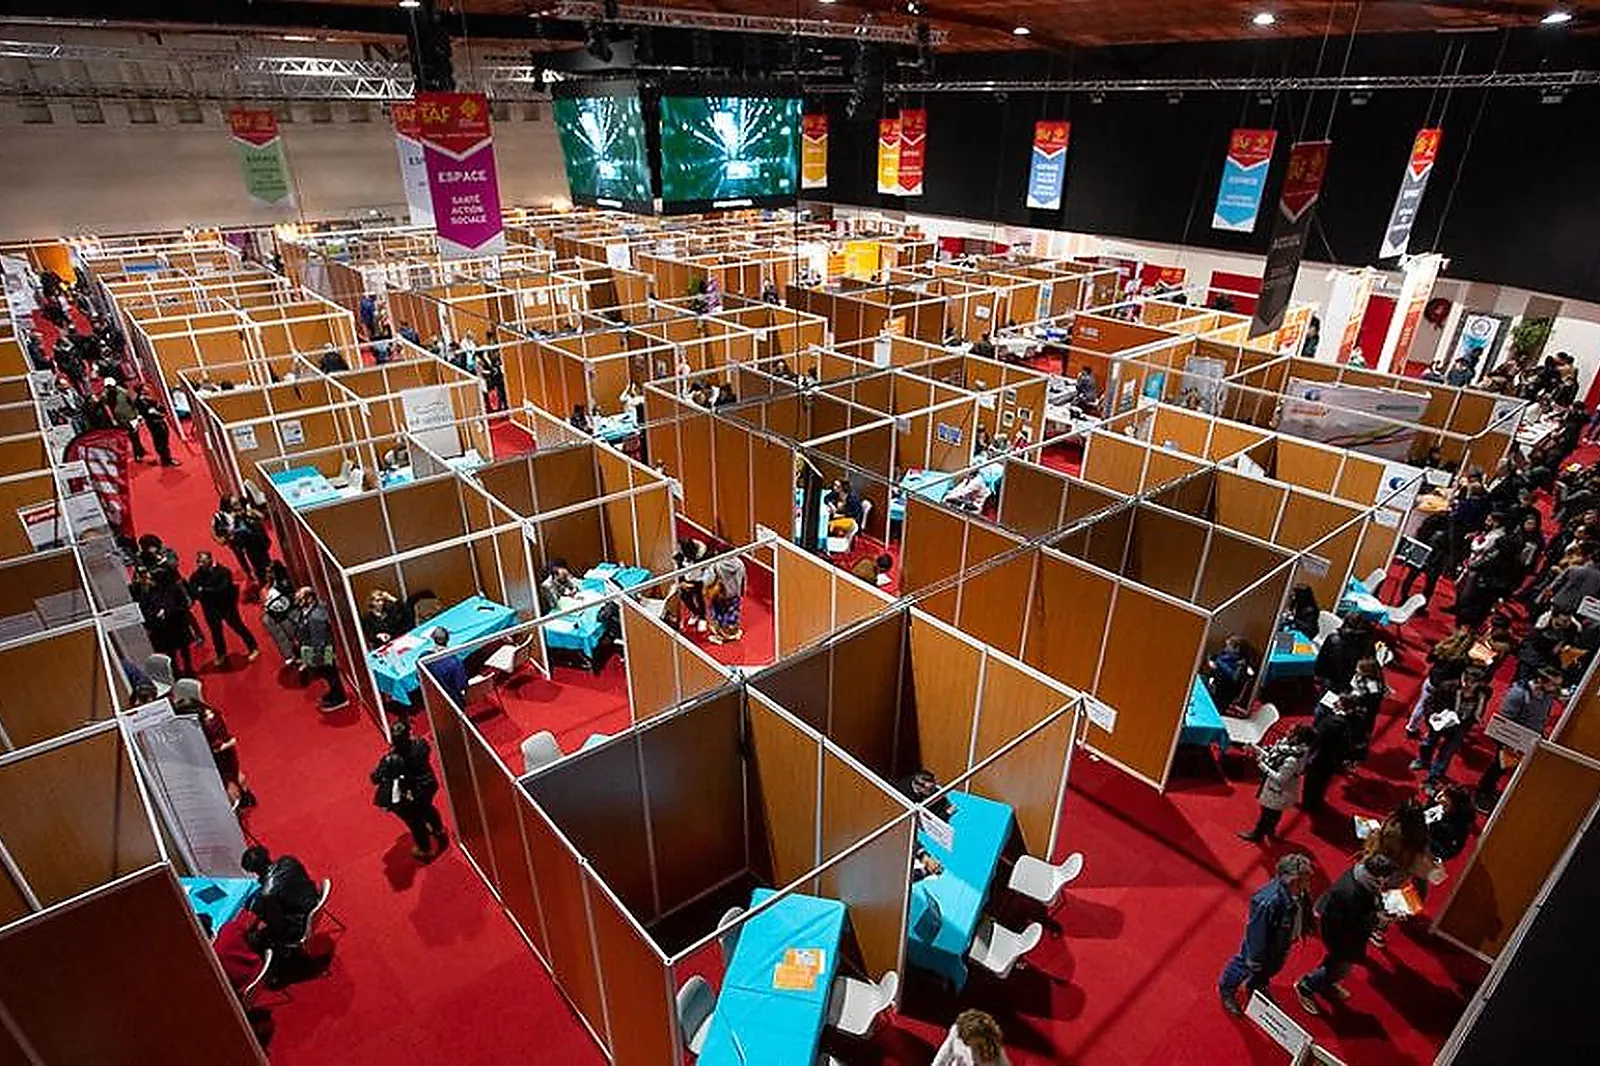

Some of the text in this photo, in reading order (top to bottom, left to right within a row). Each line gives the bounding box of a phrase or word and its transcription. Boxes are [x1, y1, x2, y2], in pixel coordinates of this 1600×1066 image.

[438, 169, 488, 183] ESPACE
[451, 205, 484, 215] ACTION
[450, 214, 488, 225] SOCIALE
